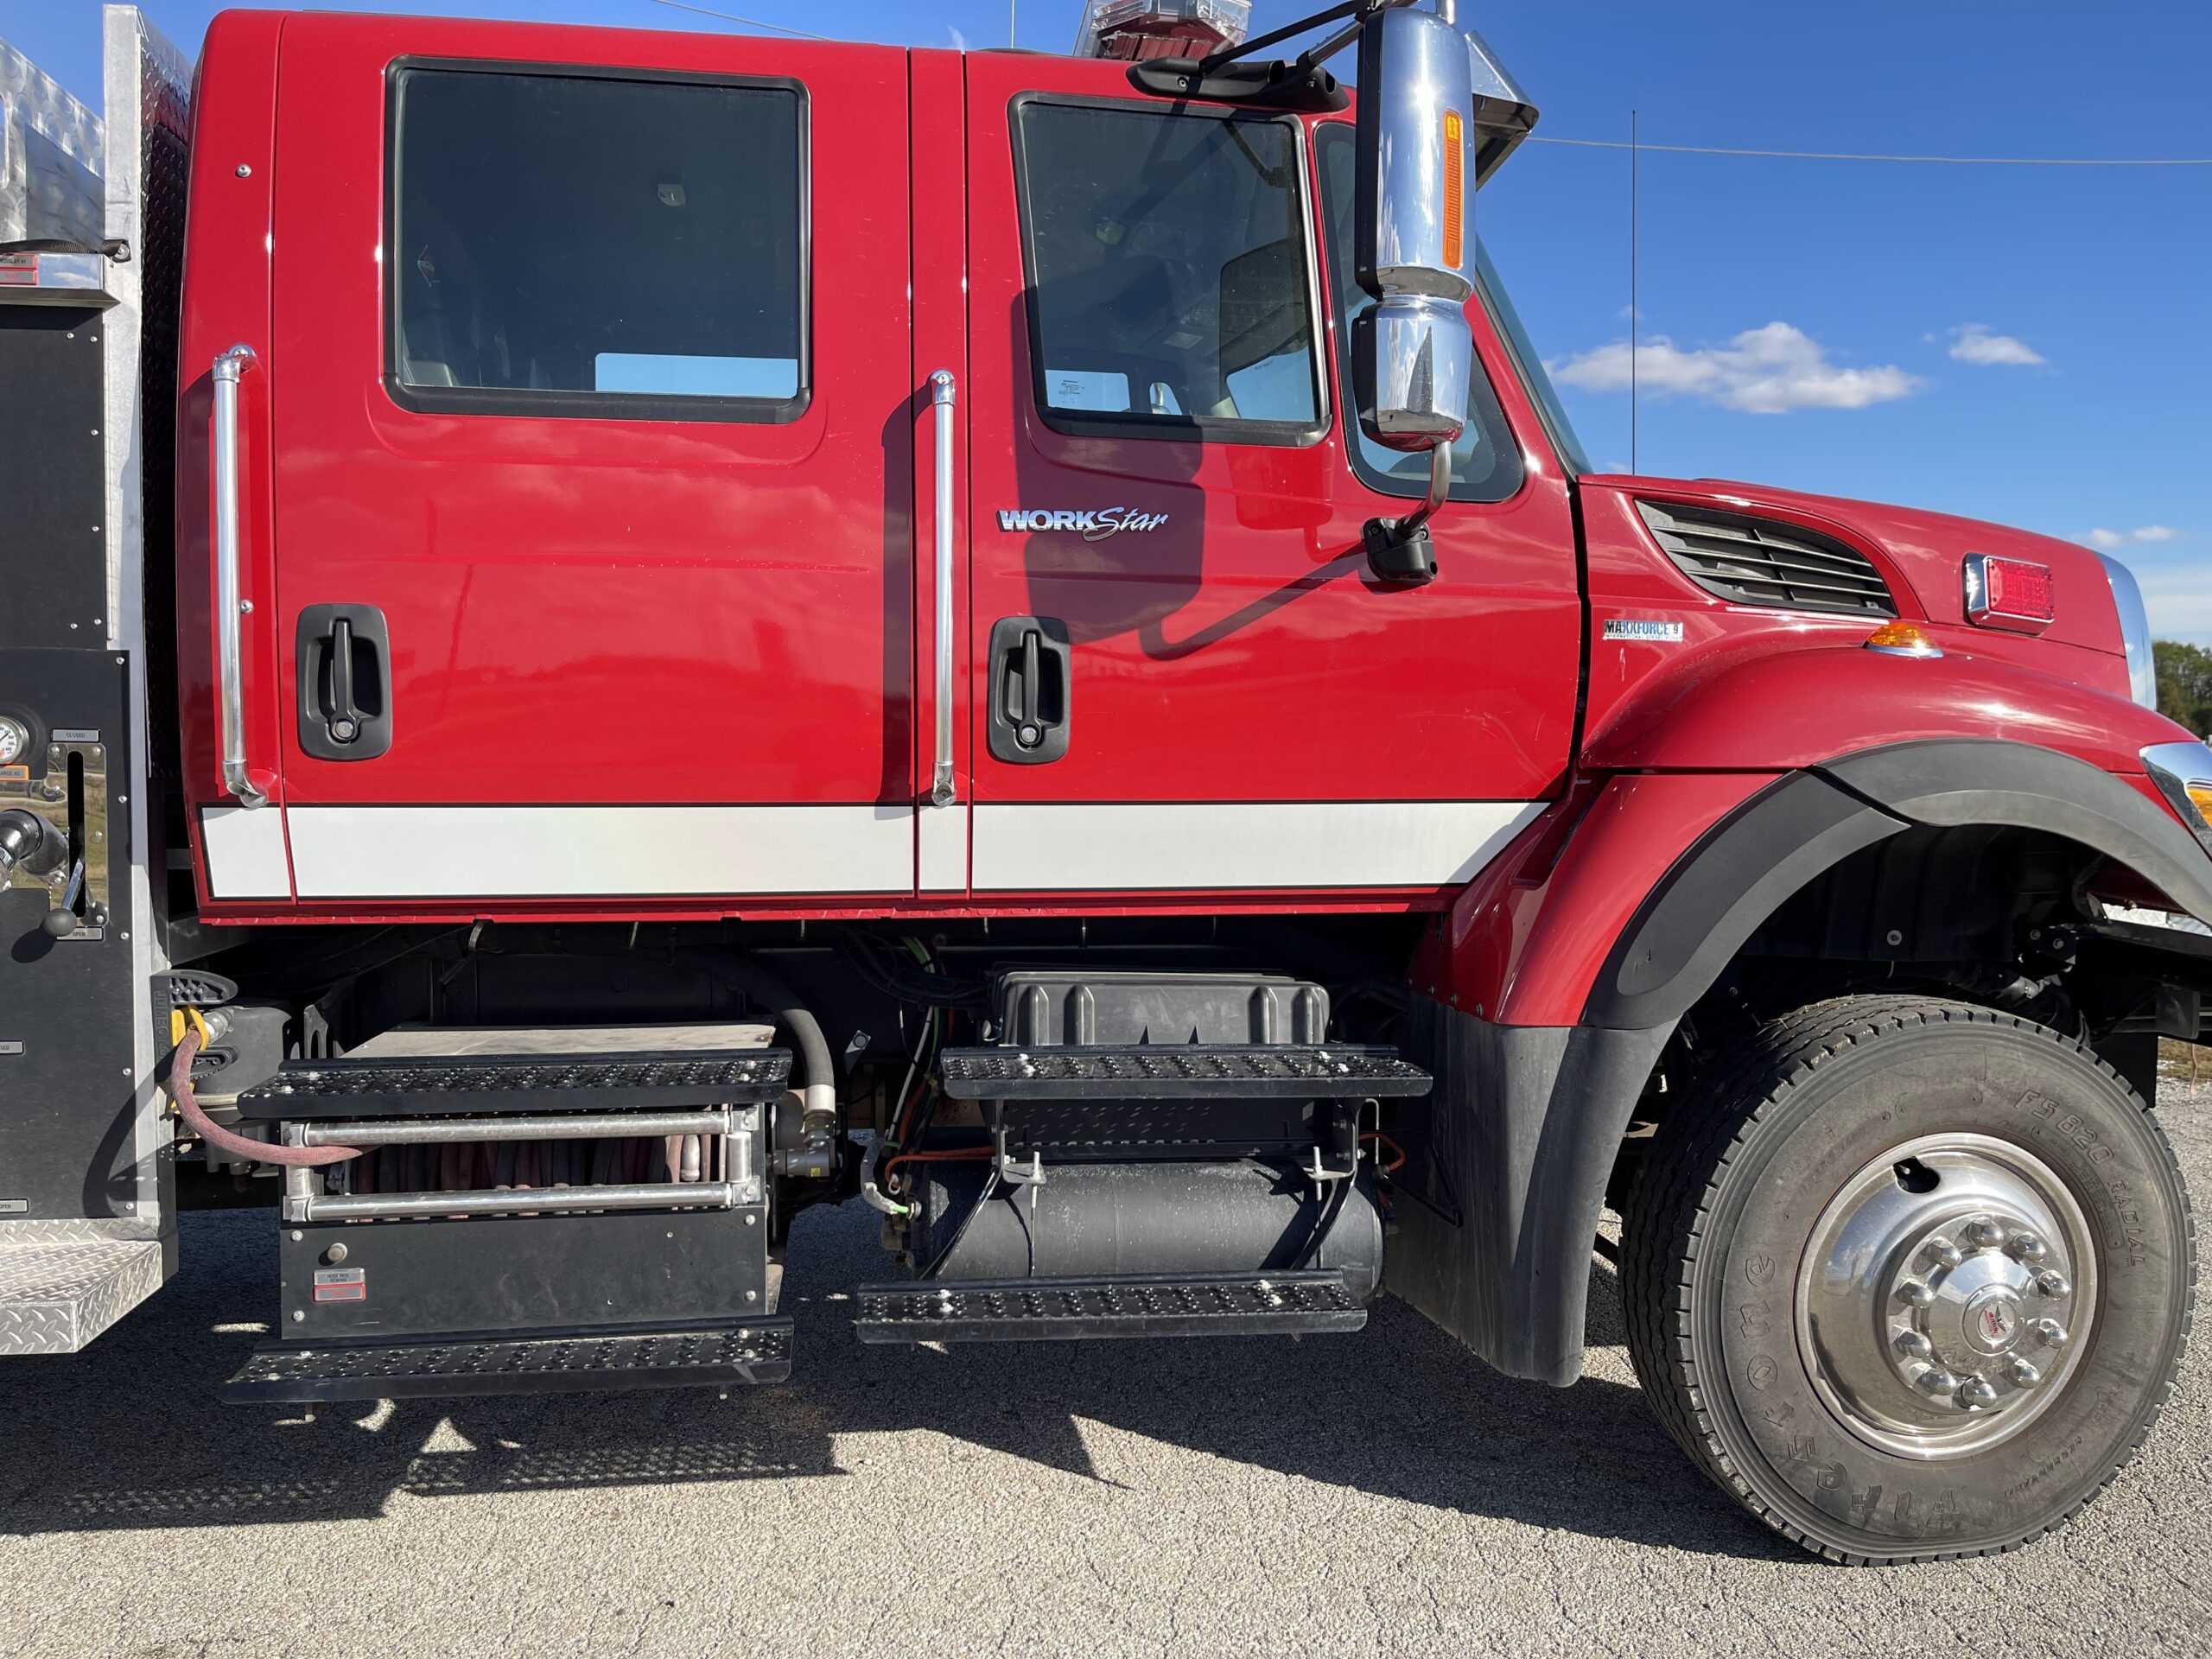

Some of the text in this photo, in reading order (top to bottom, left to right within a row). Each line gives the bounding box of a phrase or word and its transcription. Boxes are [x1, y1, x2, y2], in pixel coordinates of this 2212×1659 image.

[1605, 620, 1679, 635] MAXXFORCE 9
[2107, 1179, 2146, 1268] RADIAL
[1740, 1253, 1960, 1539] Firestone
